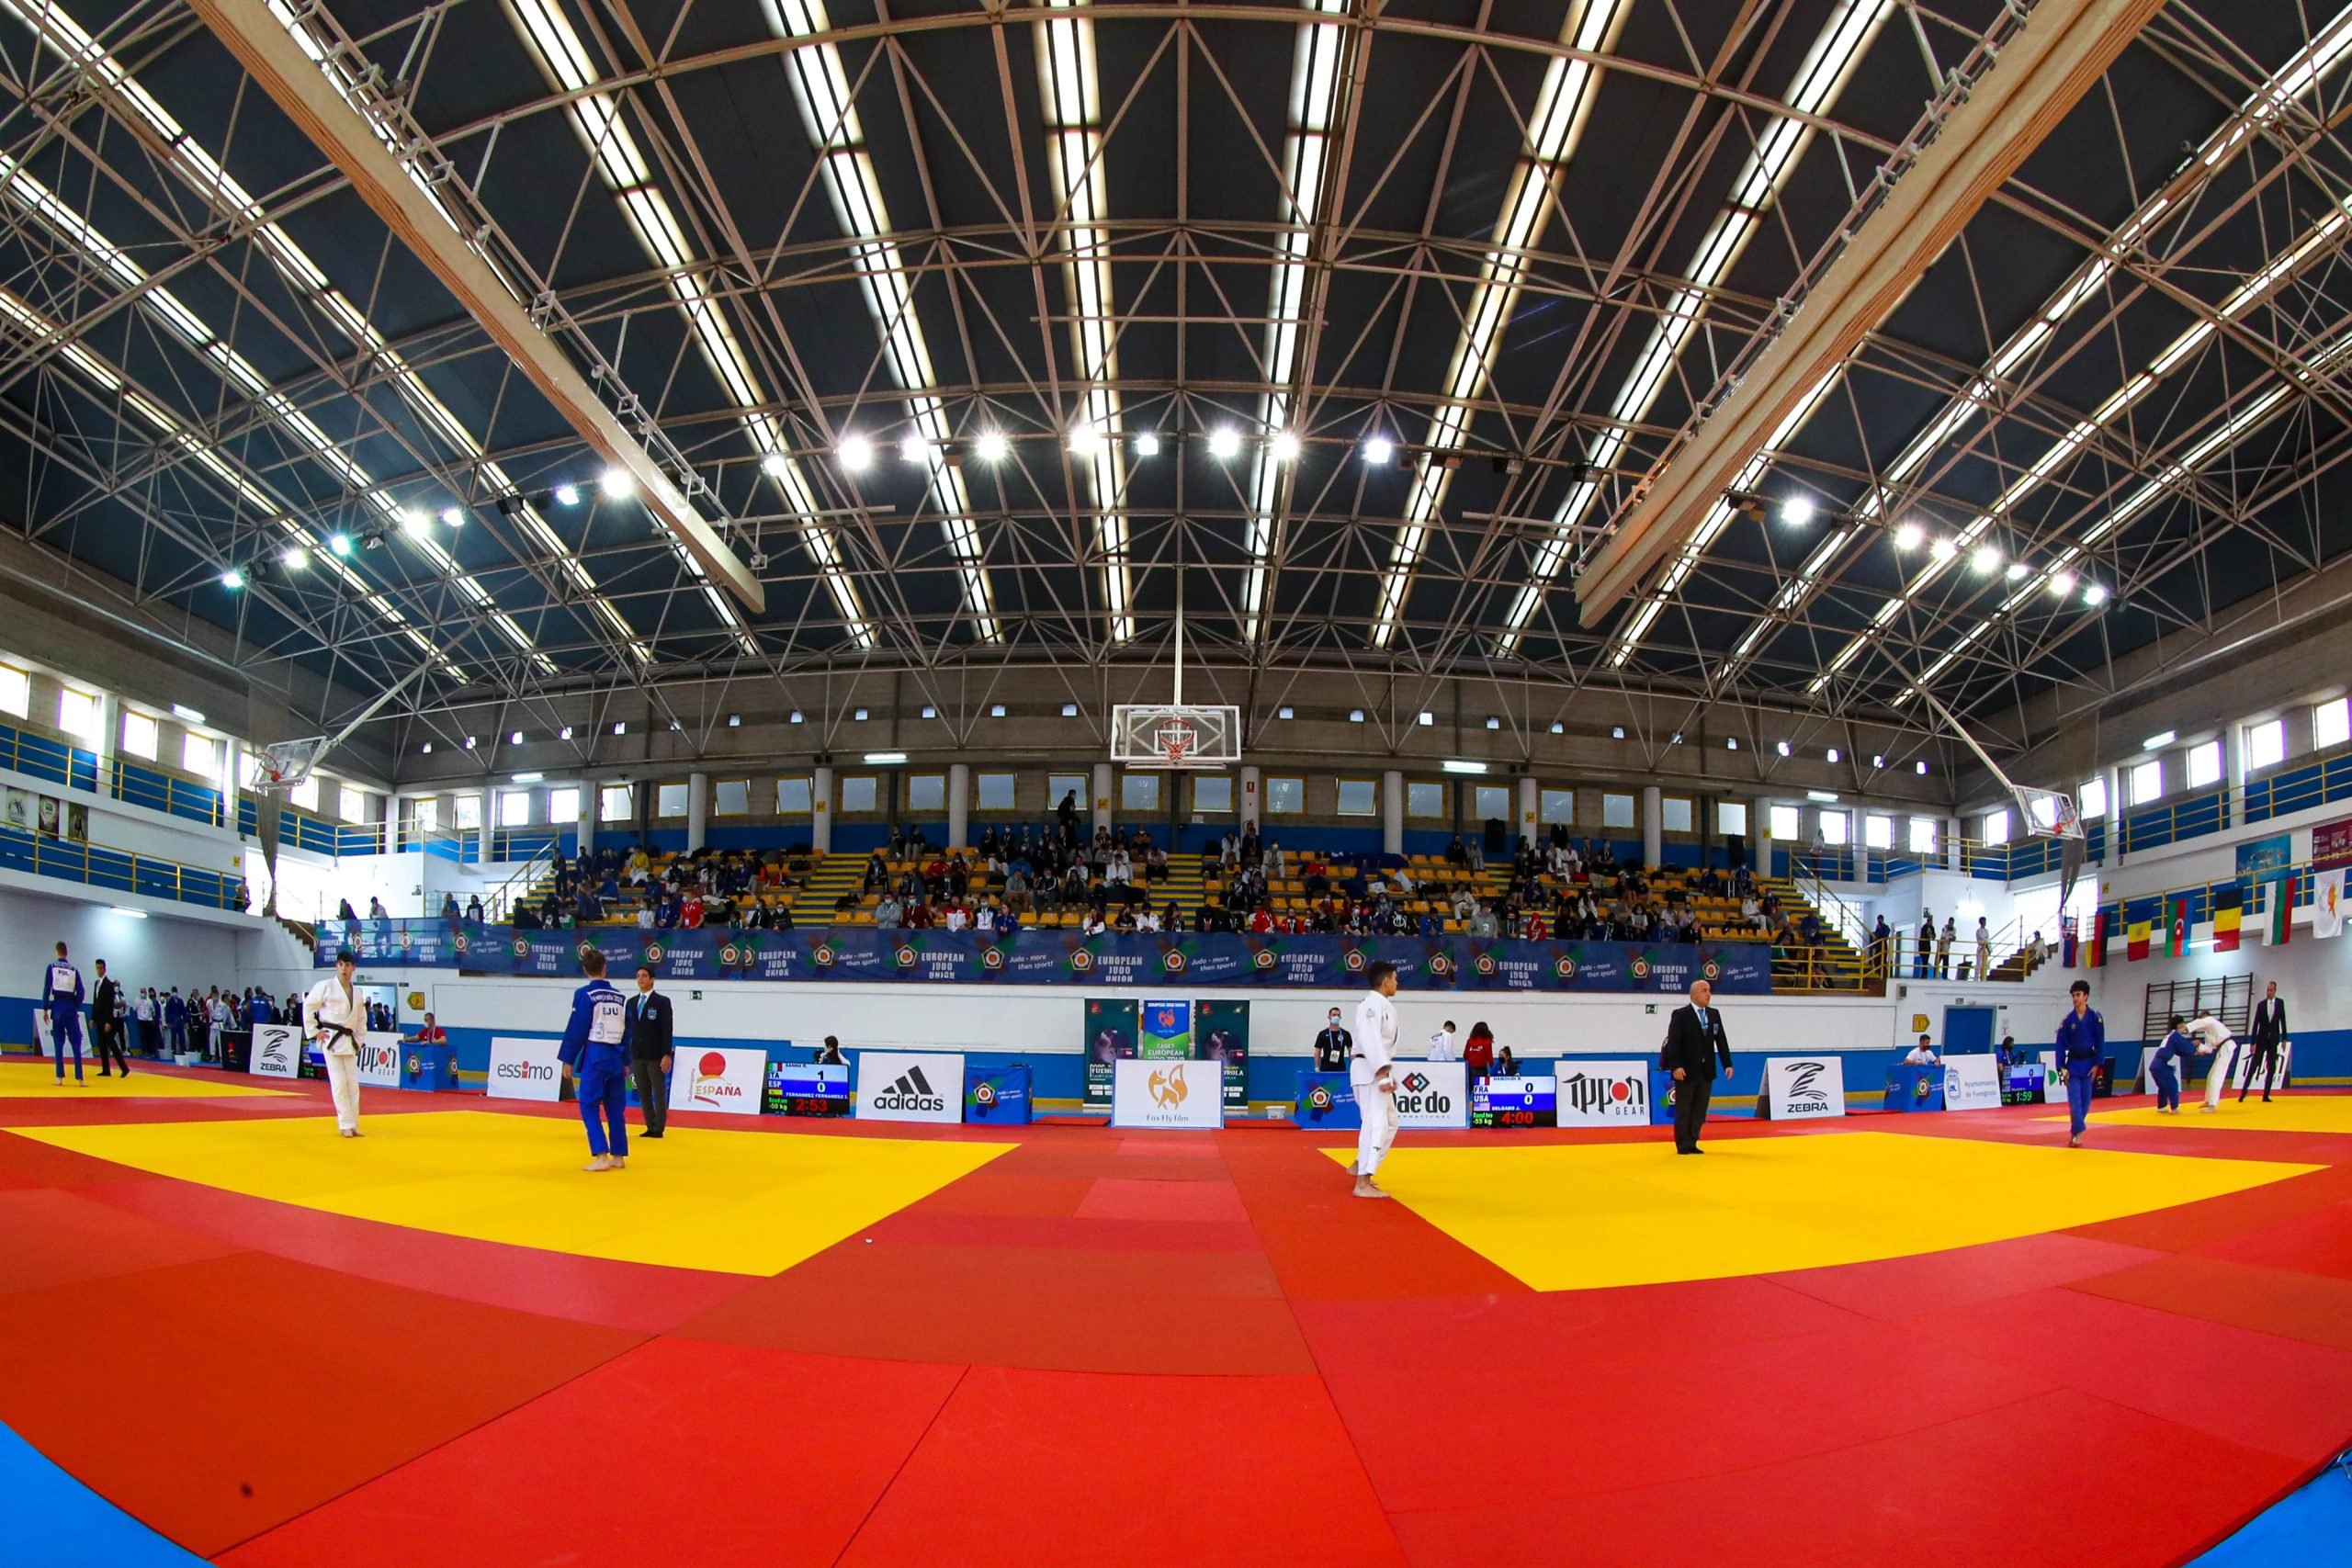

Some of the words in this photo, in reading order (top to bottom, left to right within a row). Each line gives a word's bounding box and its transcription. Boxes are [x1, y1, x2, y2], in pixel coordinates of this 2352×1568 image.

[532, 944, 564, 953] EUROPEAN
[539, 953, 556, 962] JUDO
[667, 950, 704, 959] EUROPEAN
[759, 951, 797, 960] EUROPEAN
[922, 953, 964, 963] EUROPEAN
[1281, 954, 1324, 964] EUROPEAN
[675, 959, 693, 967] JUDO
[768, 960, 786, 968] JUDO
[1098, 955, 1143, 965] EUROPEAN
[1192, 958, 1206, 966] Judo
[537, 962, 557, 971] UNION
[932, 962, 953, 971] JUDO
[1035, 960, 1054, 970] sport!
[1200, 964, 1216, 972] than
[1216, 962, 1237, 972] sport!
[1292, 964, 1313, 973] JUDO
[1396, 964, 1414, 973] port!
[1499, 962, 1538, 972] EUROPEAN
[1653, 964, 1687, 974] EUROPEAN
[672, 967, 695, 976] UNION
[765, 968, 789, 976] UNION
[1108, 965, 1130, 975] JUDO
[929, 971, 955, 979] UNION
[1105, 975, 1133, 983] UNION
[1288, 973, 1314, 982] UNION
[1510, 971, 1529, 980] JUDO
[1662, 974, 1679, 982] JUDO
[1508, 979, 1532, 987] UNION
[1660, 983, 1681, 991] UNION
[260, 1063, 287, 1073] ZEBRA
[379, 1068, 395, 1077] GEAR
[497, 1061, 553, 1080] essimo
[2029, 1068, 2034, 1077] 0
[818, 1070, 824, 1080] 1
[768, 1080, 782, 1089] ESP
[817, 1082, 826, 1093] 0
[1964, 1080, 1996, 1089] Ayuntamiento
[2029, 1077, 2032, 1087] 1
[695, 1083, 741, 1097] ESPAÑA
[1525, 1082, 1533, 1093] 0
[1973, 1089, 1996, 1100] Fuengirola
[2016, 1090, 2032, 1102] 1:59
[874, 1093, 944, 1111] adidas
[1425, 1090, 1451, 1114] do
[1524, 1094, 1533, 1106] 0
[796, 1099, 828, 1112] 2:53
[1787, 1102, 1828, 1112] ZEBRA
[1615, 1106, 1645, 1115] GEAR
[1147, 1114, 1159, 1122] Fox
[1161, 1114, 1173, 1123] Fly
[1174, 1114, 1189, 1122] film
[1484, 1118, 1492, 1126] kg
[1501, 1111, 1533, 1125] 4:00
